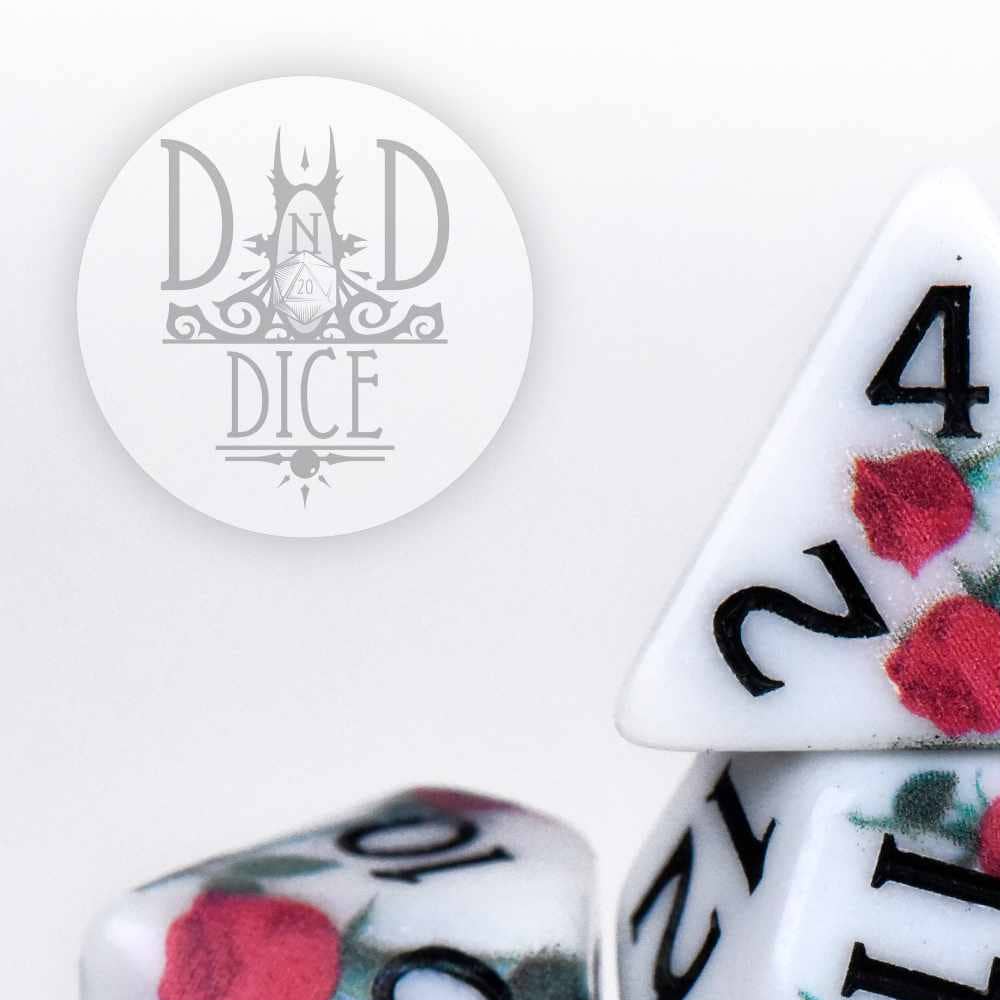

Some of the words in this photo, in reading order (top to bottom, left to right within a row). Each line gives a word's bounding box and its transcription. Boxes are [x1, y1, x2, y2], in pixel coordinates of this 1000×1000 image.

[866, 285, 989, 439] 4
[713, 540, 889, 697] 2
[337, 815, 516, 883] 10
